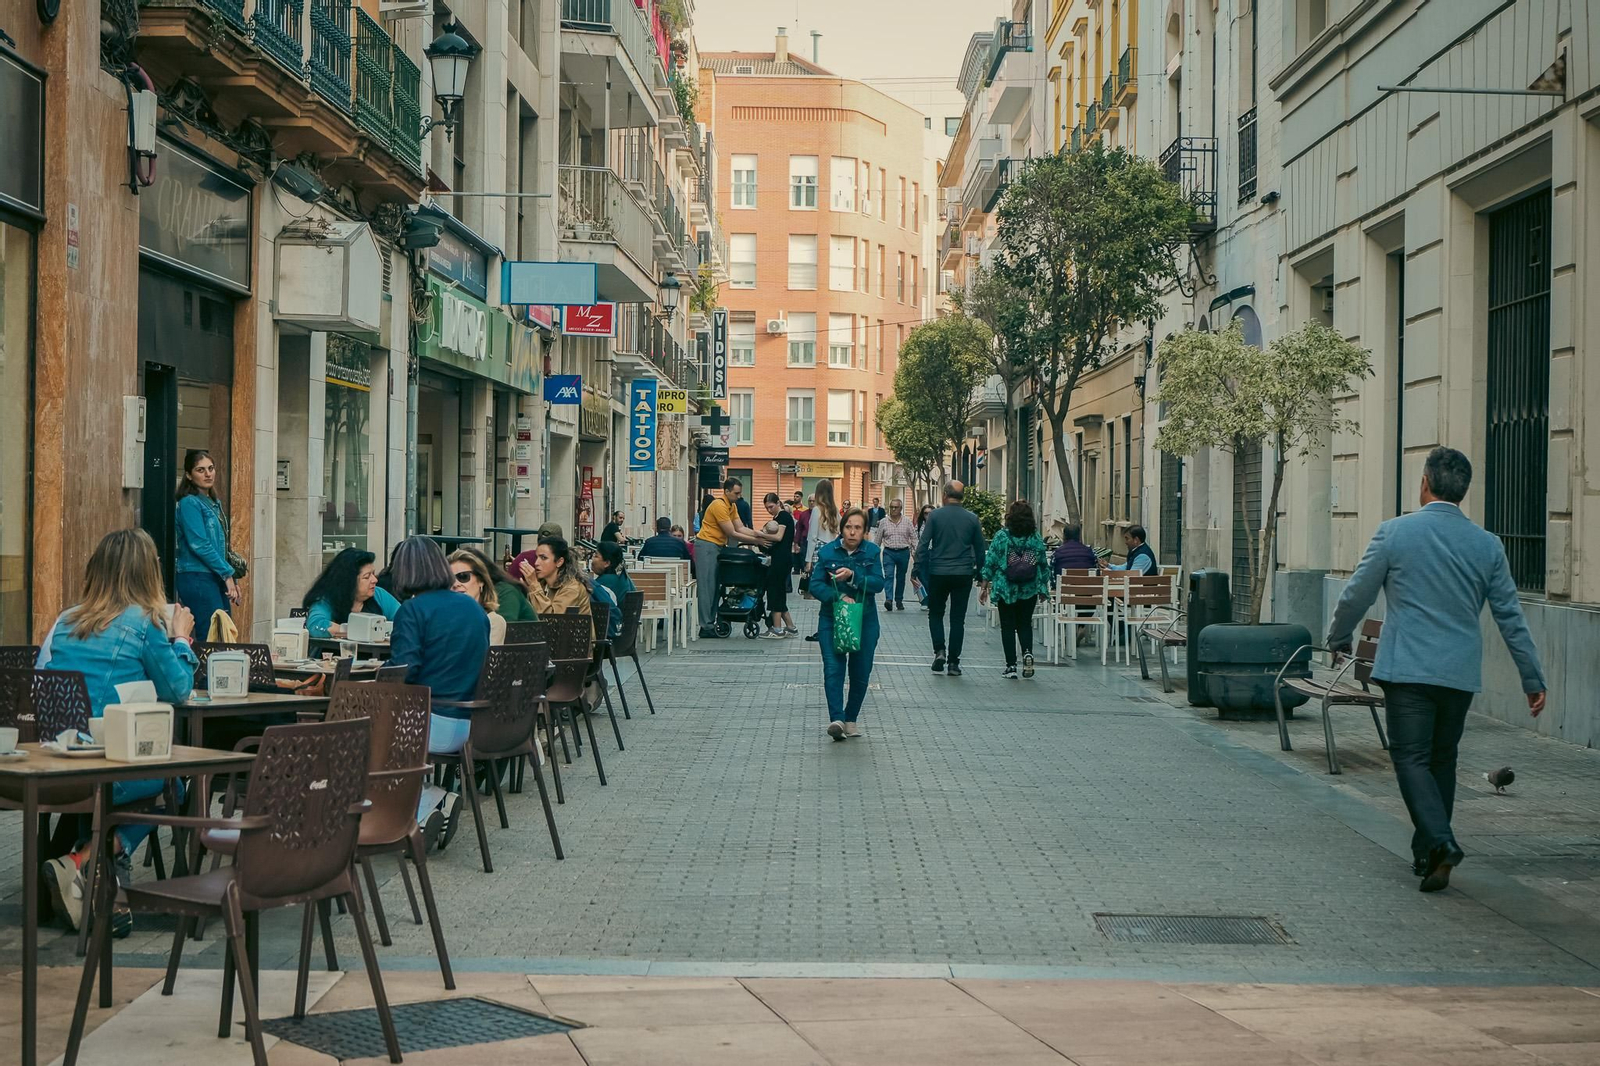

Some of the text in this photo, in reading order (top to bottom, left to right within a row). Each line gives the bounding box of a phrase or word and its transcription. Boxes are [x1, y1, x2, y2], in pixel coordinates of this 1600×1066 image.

[714, 313, 725, 397] VIDOSA
[555, 386, 579, 398] AXA
[658, 391, 686, 401] MPRO
[634, 389, 652, 461] TATTOO
